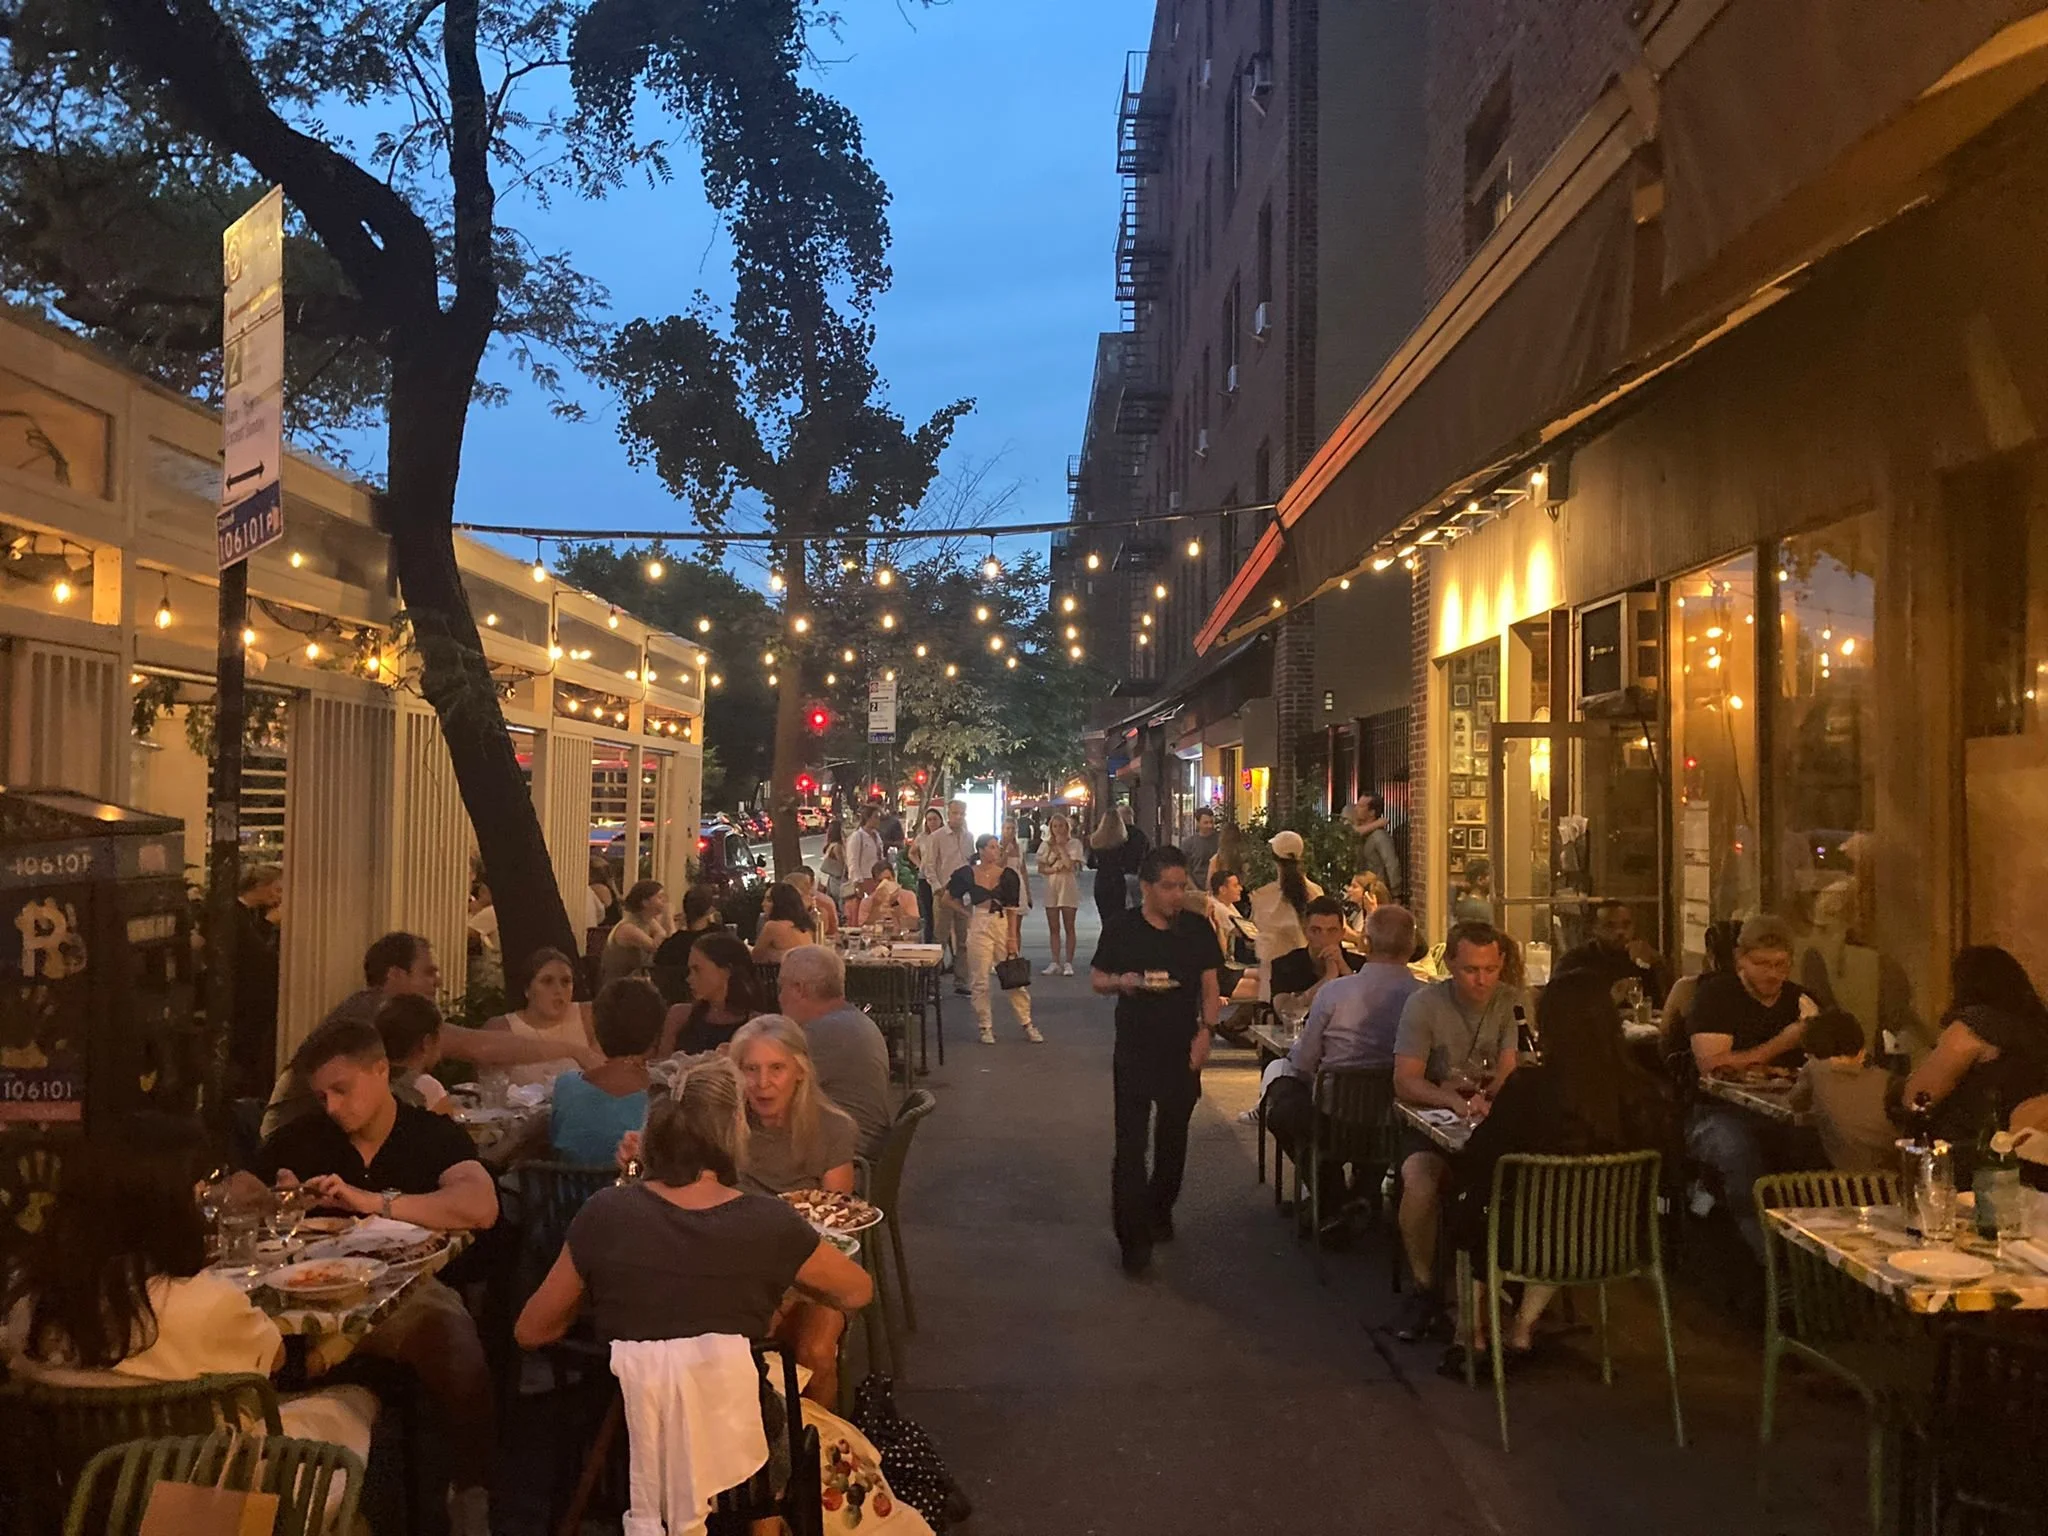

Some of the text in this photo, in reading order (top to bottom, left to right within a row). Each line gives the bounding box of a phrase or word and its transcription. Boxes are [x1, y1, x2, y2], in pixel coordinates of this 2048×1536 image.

[231, 346, 239, 383] 2
[219, 513, 265, 562] 106101
[15, 853, 91, 876] 106101
[4, 1080, 71, 1099] 106101
